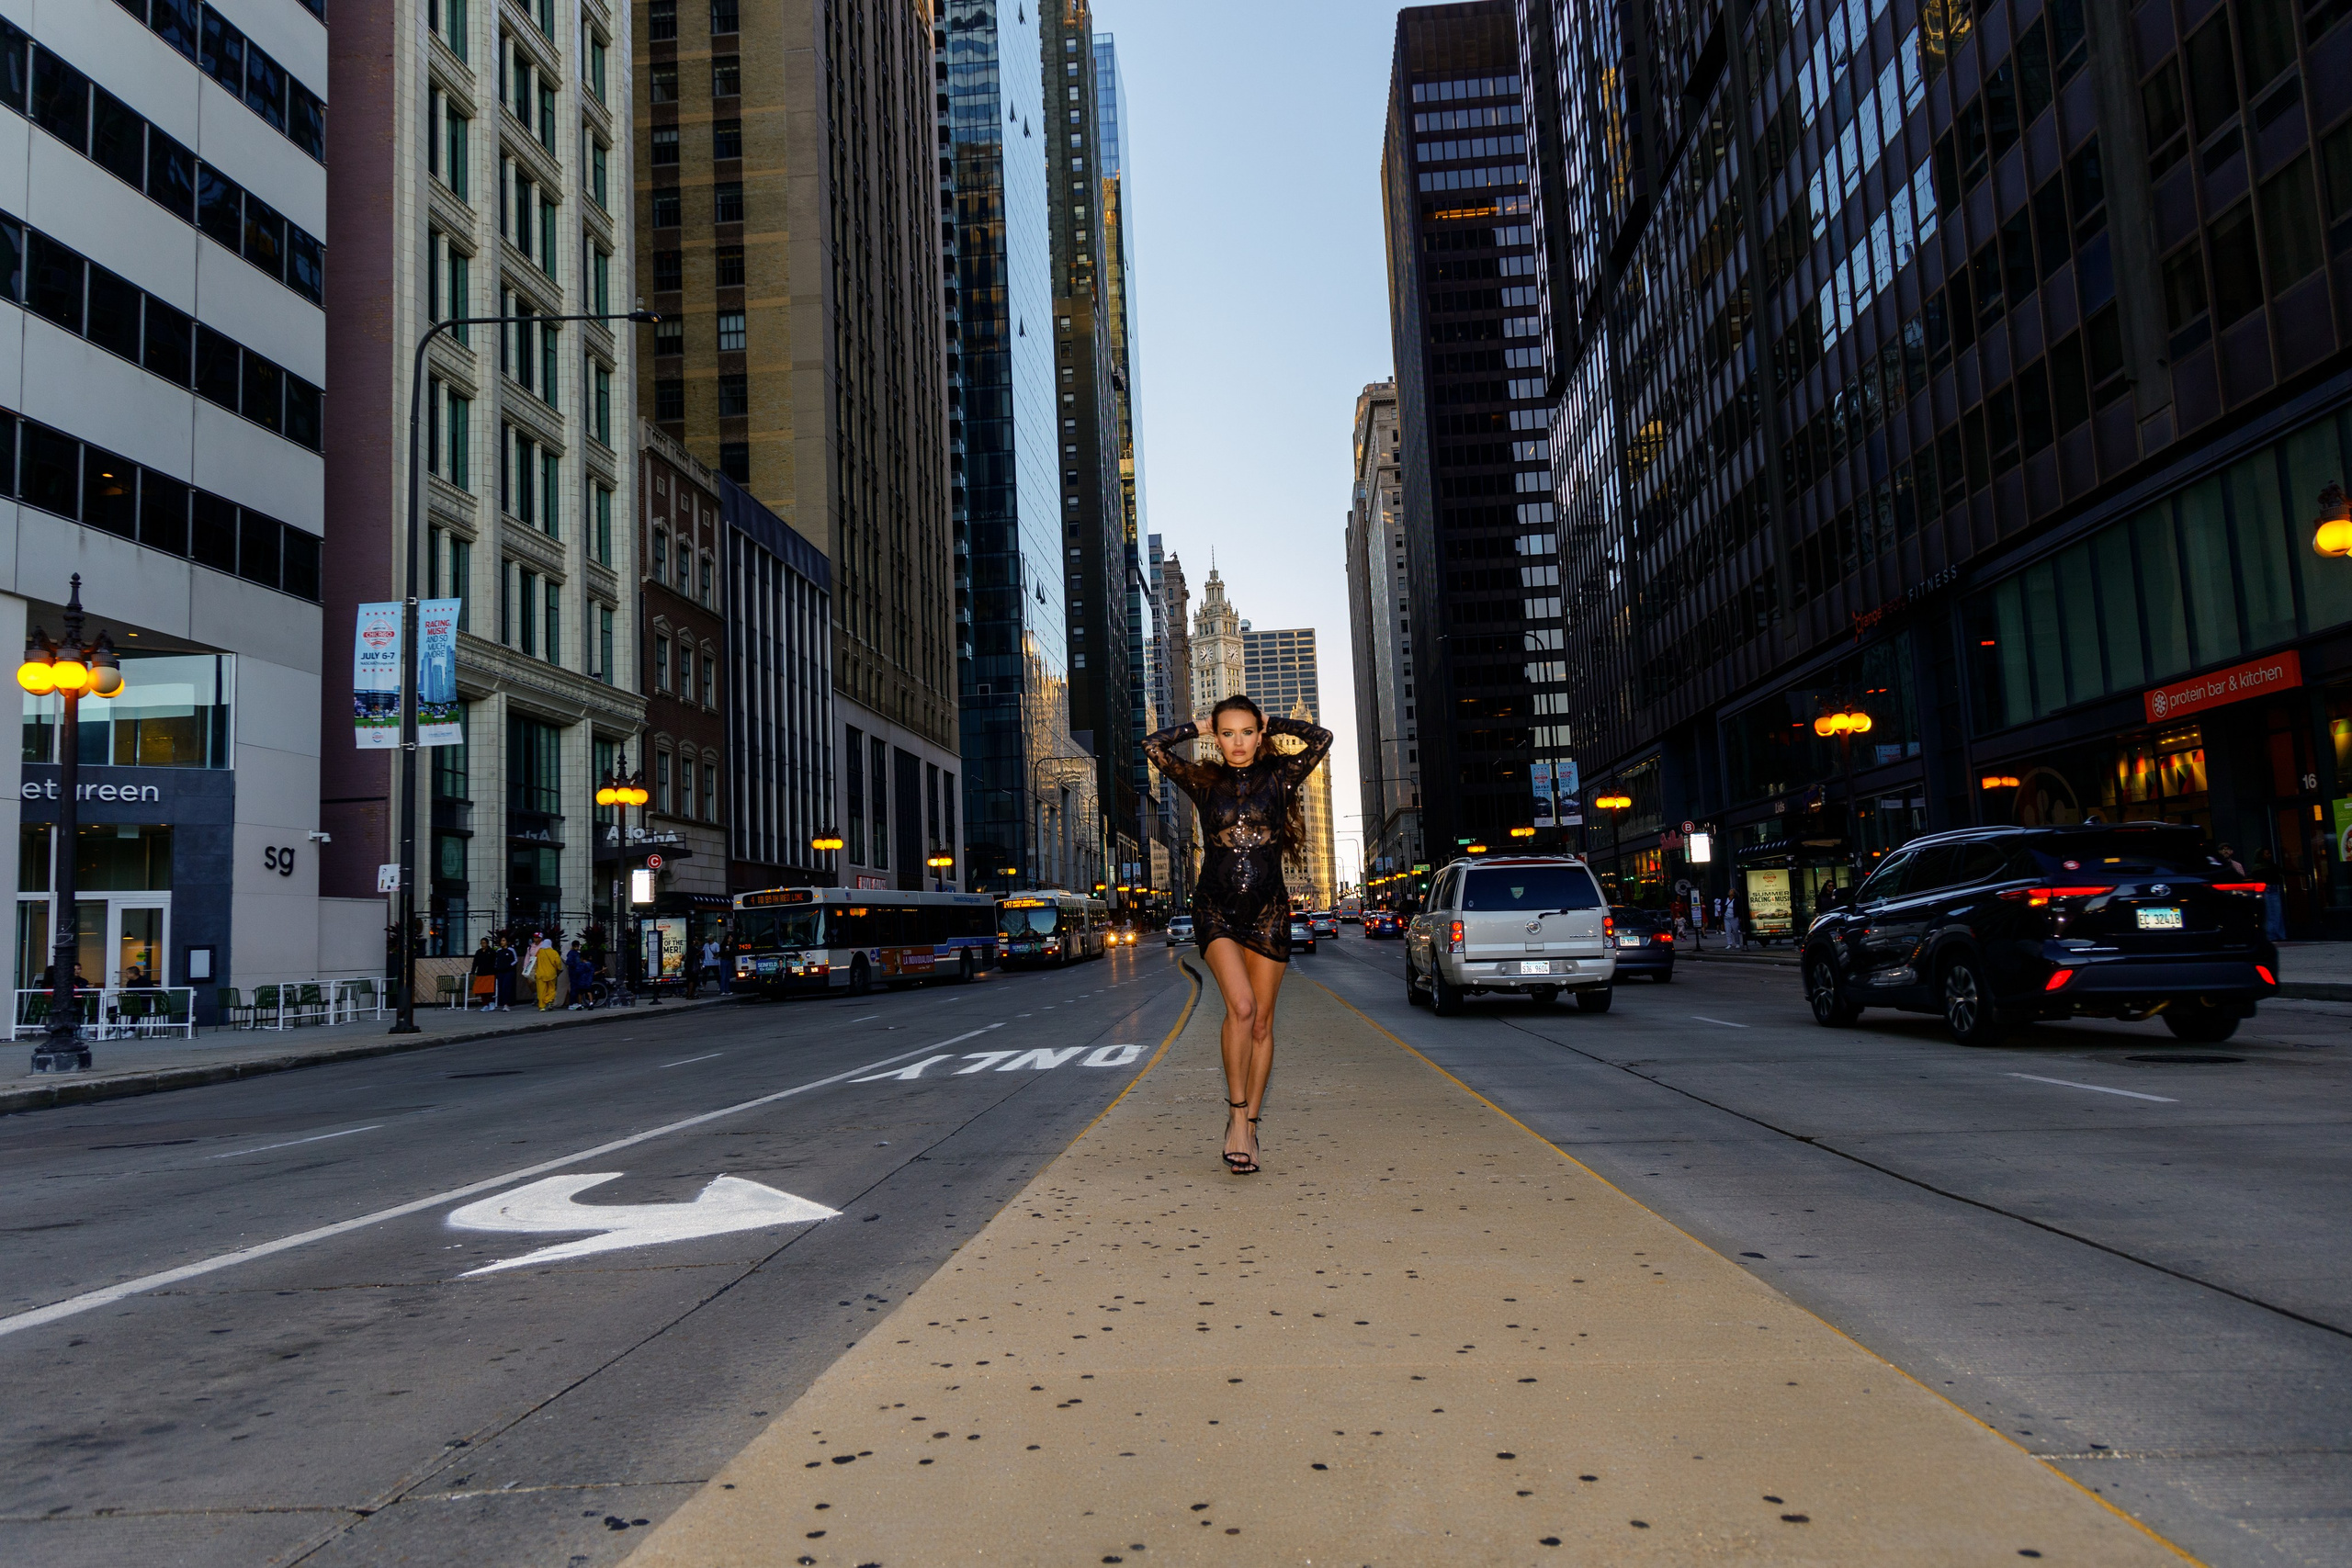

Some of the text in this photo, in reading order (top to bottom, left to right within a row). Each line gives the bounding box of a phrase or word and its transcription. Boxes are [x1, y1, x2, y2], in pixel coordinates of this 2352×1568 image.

[1908, 564, 1957, 603] FITNESS
[424, 619, 451, 627] RACING,
[427, 627, 447, 636] MUSIC
[439, 634, 448, 642] SO
[360, 651, 395, 660] JULY 6-7
[427, 650, 446, 659] MORE
[2170, 666, 2283, 709] protein bar & kitchen
[2302, 773, 2317, 789] 16
[76, 784, 159, 802] reen
[1775, 801, 1785, 814] Lids
[606, 825, 646, 840] Alo
[1685, 823, 1692, 831] B
[265, 845, 295, 876] sg
[650, 857, 659, 866] C
[2139, 913, 2181, 925] EC 32418
[1535, 964, 1549, 973] 9604
[846, 1043, 1149, 1083] ONLY
